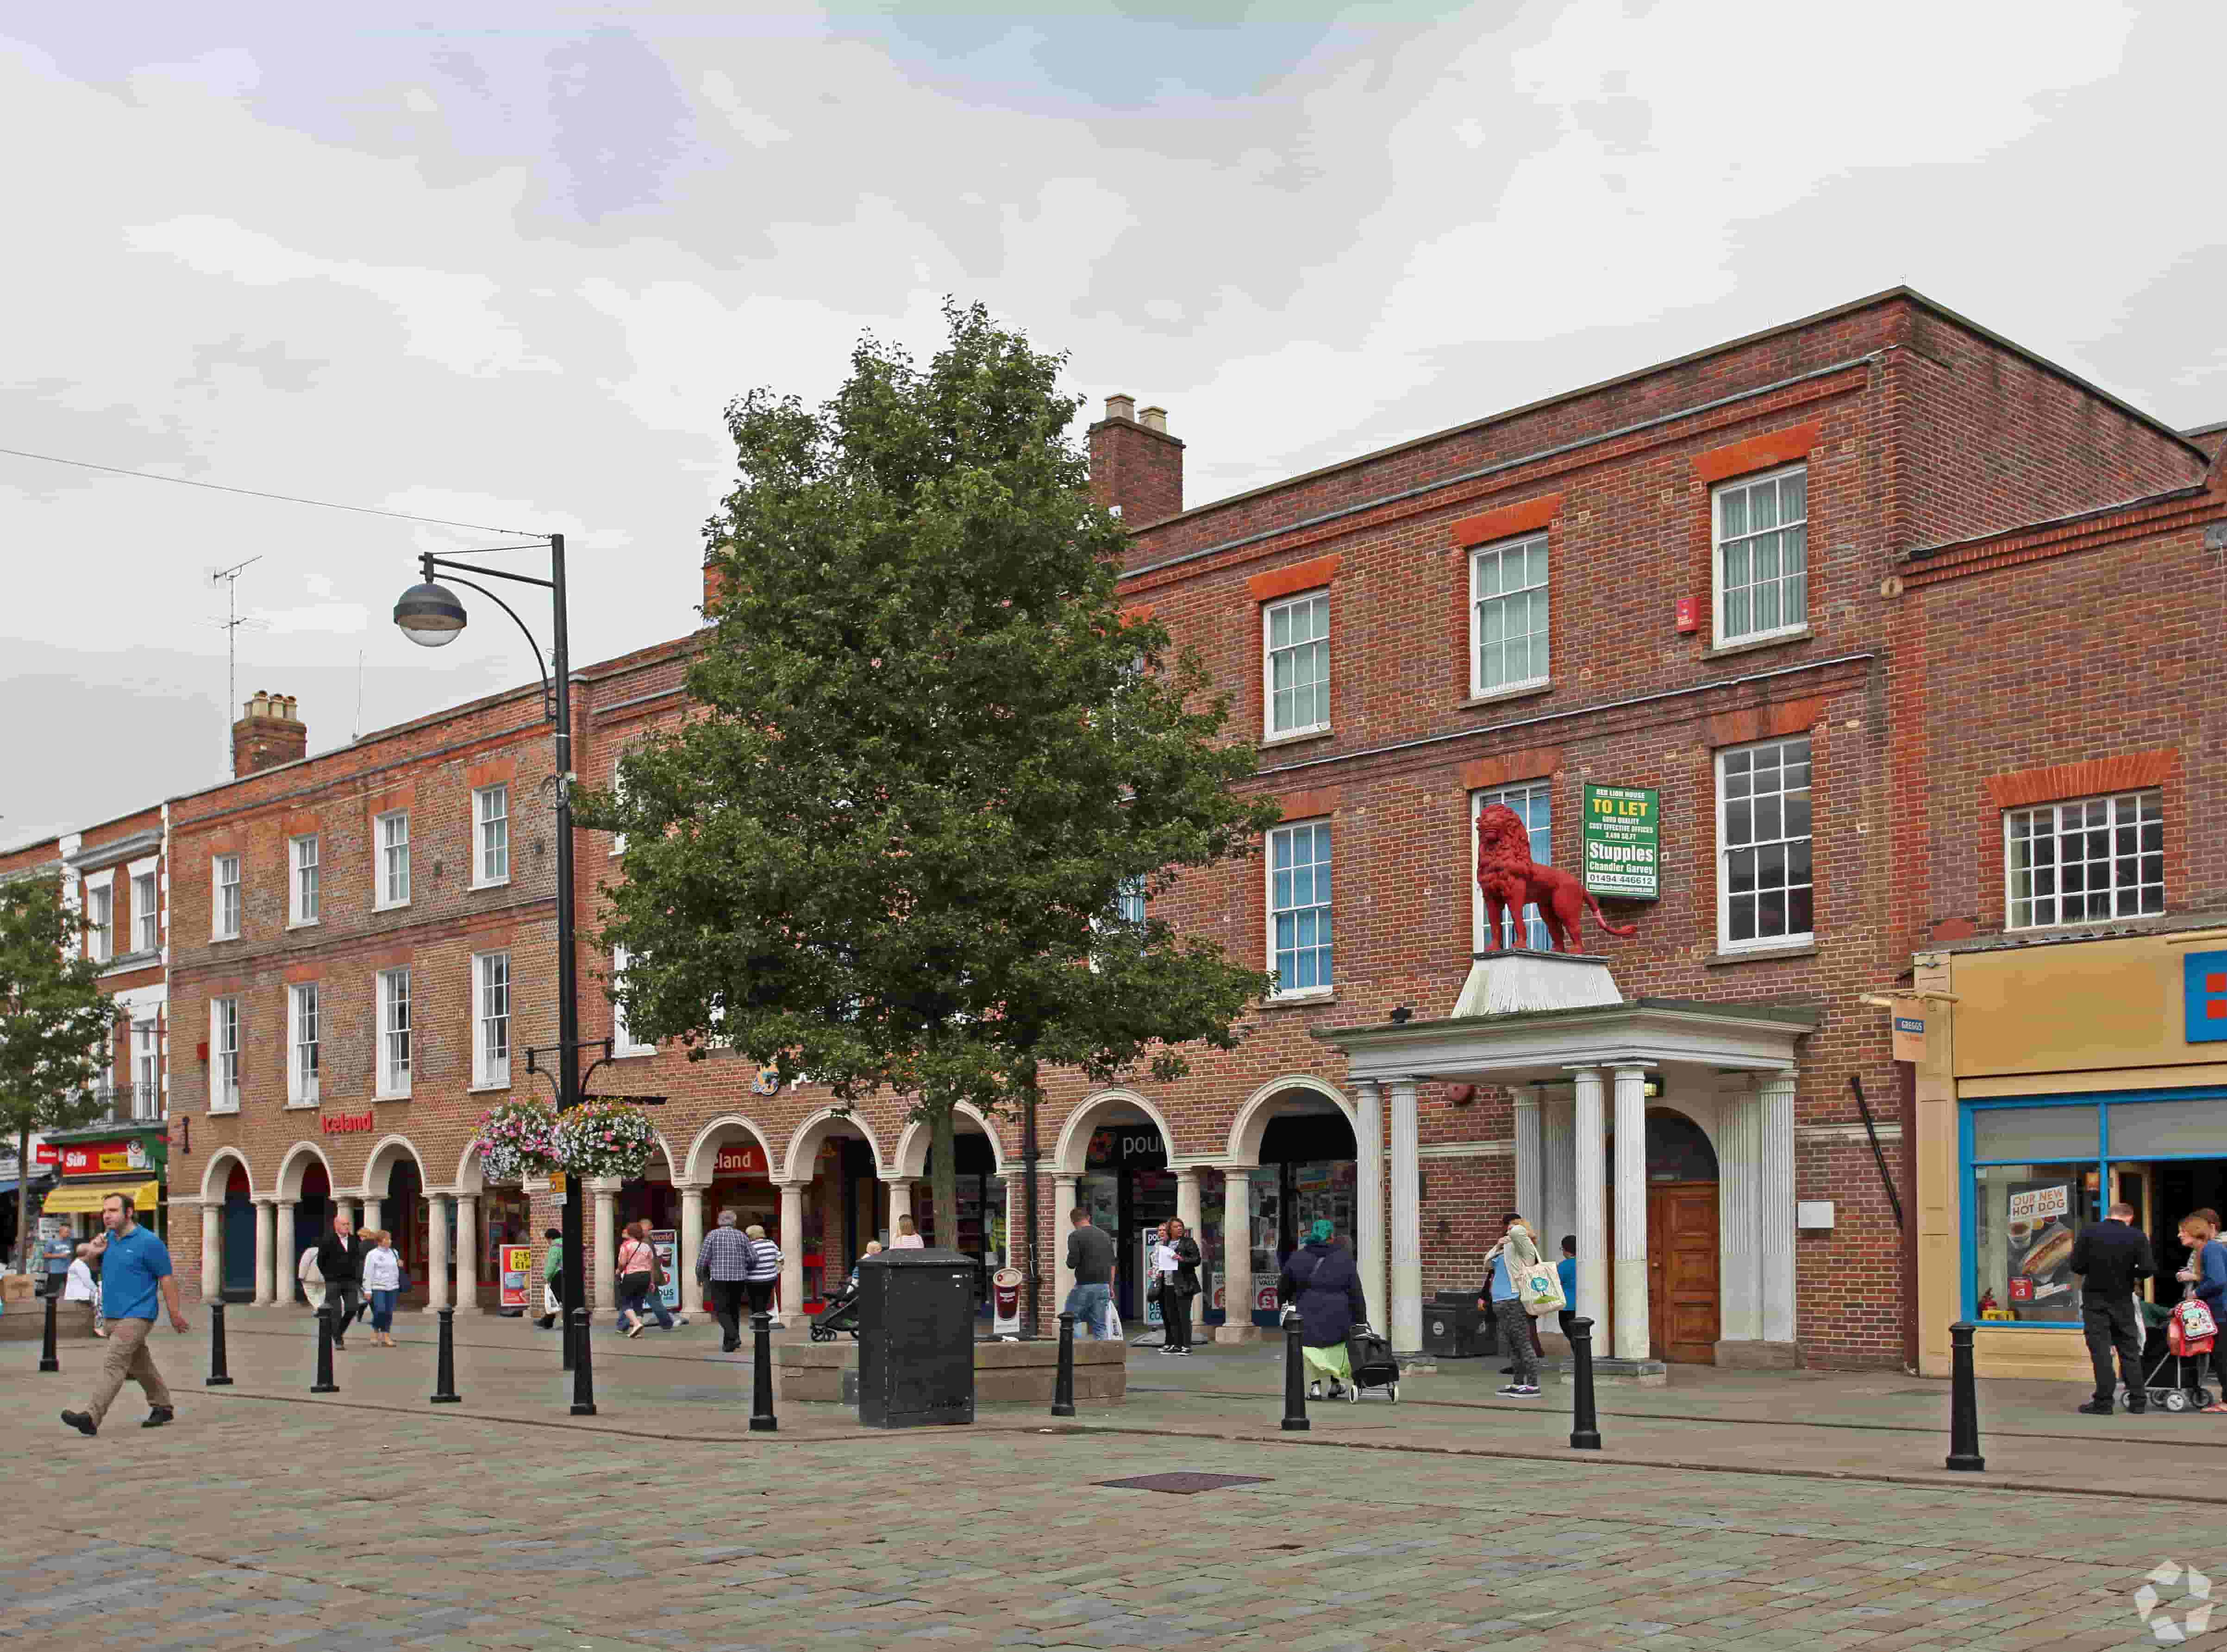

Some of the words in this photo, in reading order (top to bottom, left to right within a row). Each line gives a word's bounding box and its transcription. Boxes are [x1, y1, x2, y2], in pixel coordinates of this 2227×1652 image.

[1593, 798, 1613, 813] TO
[1619, 800, 1648, 817] LET
[1603, 823, 1630, 832] EFFECTIVE
[1589, 842, 1653, 862] Stupples
[1589, 861, 1624, 872] Chandler
[1626, 864, 1653, 875] Garvey
[1620, 876, 1652, 885] 446612
[1901, 1020, 1922, 1031] GREGGS
[321, 1111, 373, 1133] Iceland
[65, 1152, 87, 1167] Sun
[2014, 1195, 2034, 1206] OUR
[2039, 1190, 2063, 1201] NEW
[2013, 1204, 2034, 1216] HOT
[2038, 1200, 2064, 1212] DOG
